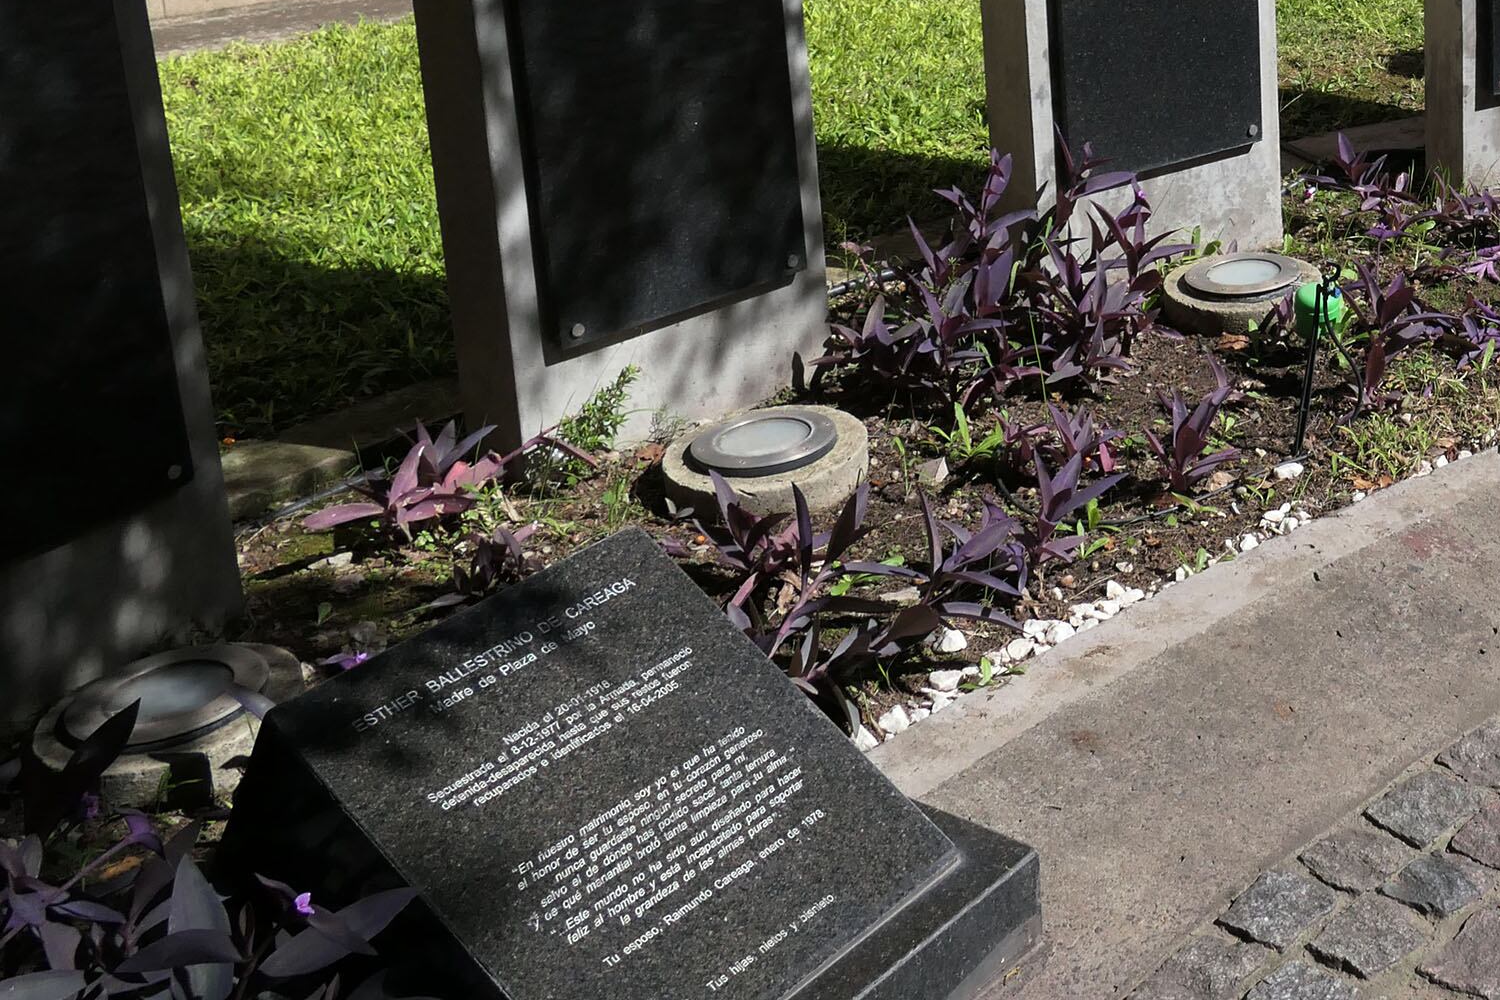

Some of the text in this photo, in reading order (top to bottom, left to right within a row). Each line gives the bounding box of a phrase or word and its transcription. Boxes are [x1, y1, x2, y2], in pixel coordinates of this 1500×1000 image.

[350, 575, 636, 729] ESTHER BALLESTRINO DE CAREAGA
[428, 619, 598, 711] Madre de Plaza de Mayo
[426, 760, 495, 803] Secuestrada
[495, 751, 509, 763] el
[509, 719, 562, 755] 8-12-1977
[563, 709, 584, 725] por
[582, 701, 597, 712] la
[638, 644, 694, 681] permaneció
[439, 658, 693, 812] detenida-desaparecida hasta que sus restos fueron
[472, 764, 539, 808] recuperados
[539, 758, 550, 767] e
[549, 720, 612, 760] identificados
[612, 711, 625, 723] el
[501, 720, 540, 745] Nacida
[540, 711, 554, 723] el
[535, 833, 575, 862] nuestro
[632, 785, 653, 802] soy
[653, 775, 668, 790] yo
[668, 765, 680, 778] el
[681, 754, 701, 771] que
[700, 743, 716, 757] ha
[716, 725, 745, 747] tenido
[565, 924, 591, 945] feliz
[591, 913, 605, 928] al
[605, 886, 646, 917] hombre
[647, 879, 658, 892] y
[683, 821, 744, 865] incapacitado
[744, 805, 768, 826] para
[766, 778, 806, 809] soportar
[601, 952, 621, 967] Tu
[662, 887, 713, 926] Raimundo
[758, 838, 785, 859] enero
[785, 826, 800, 839] de
[705, 972, 729, 992] Tus
[757, 928, 788, 954] nietos
[788, 921, 799, 933] y
